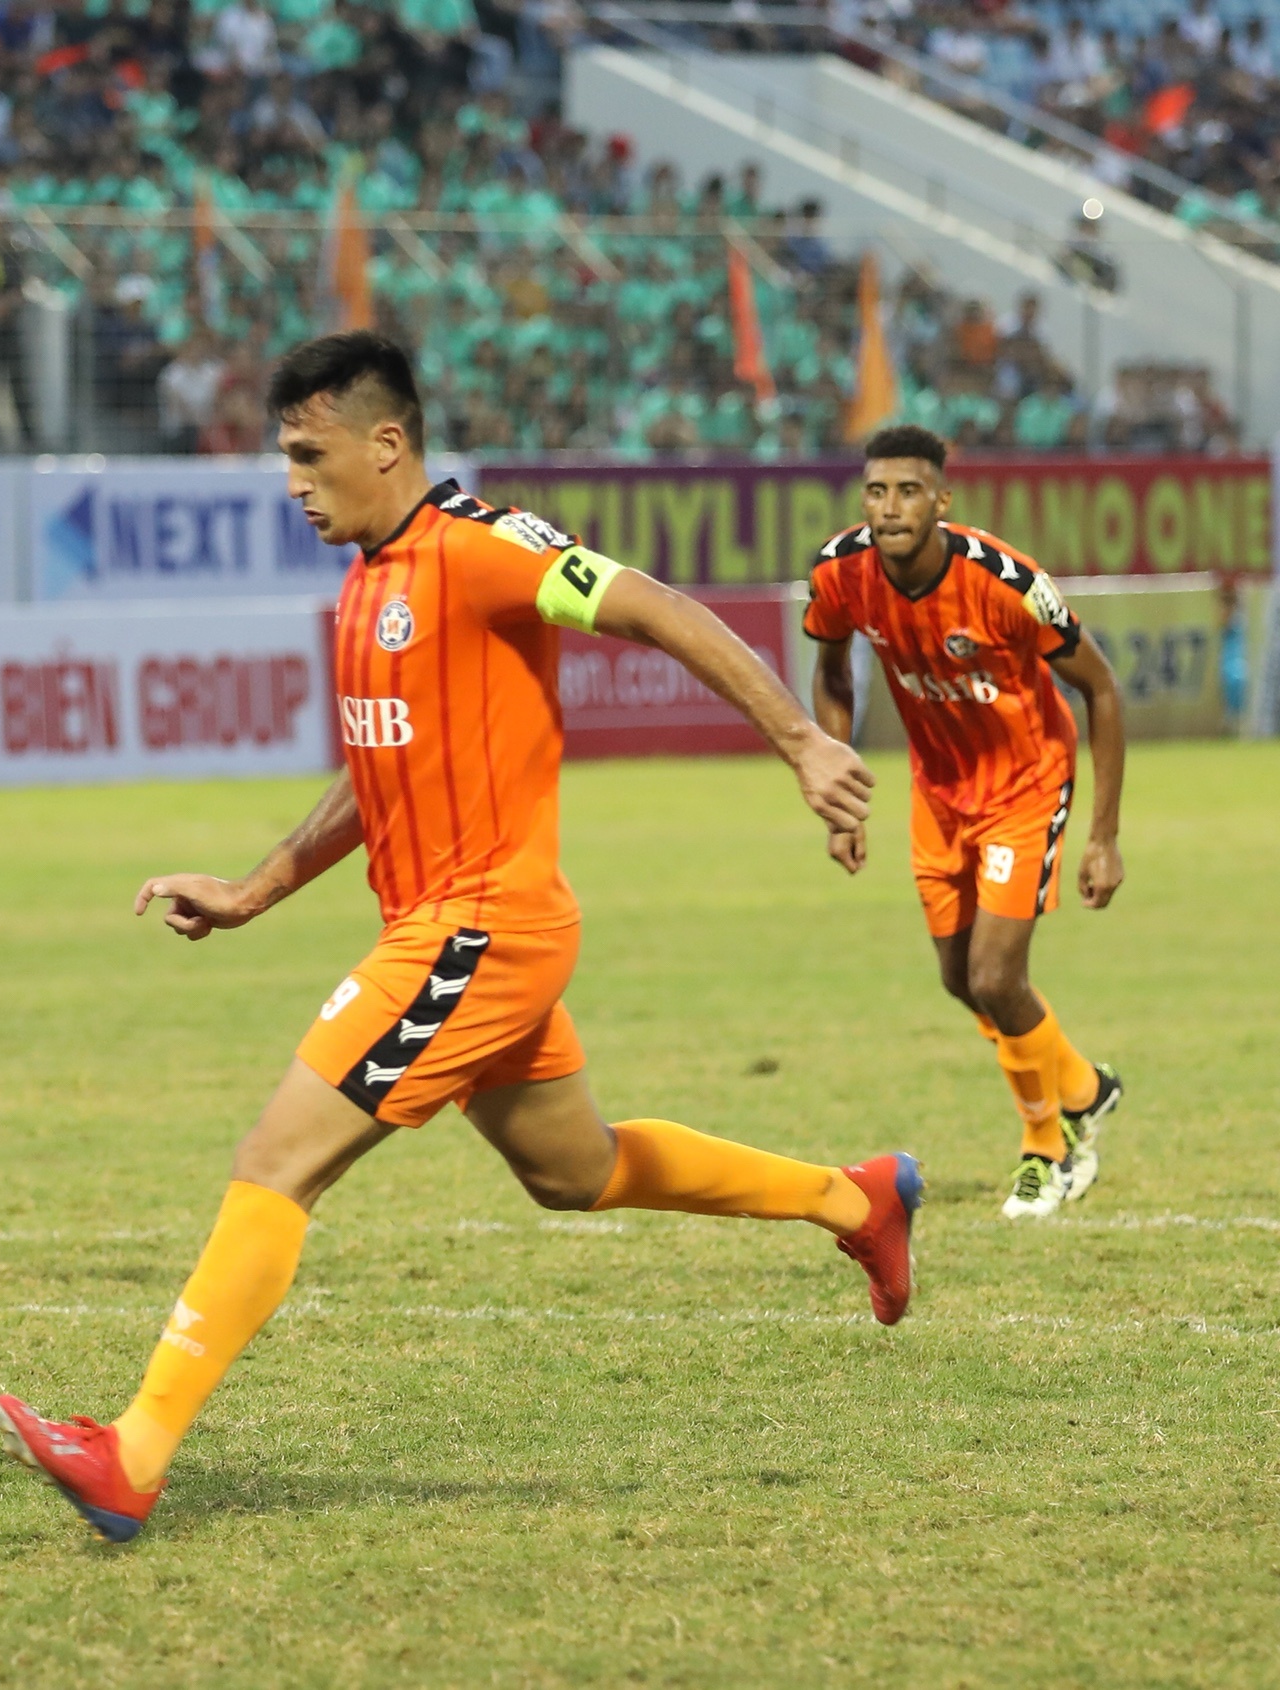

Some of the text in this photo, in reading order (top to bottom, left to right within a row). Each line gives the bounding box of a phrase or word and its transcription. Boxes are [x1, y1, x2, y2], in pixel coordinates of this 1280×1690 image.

[109, 495, 250, 576] NEXT
[561, 554, 598, 598] C
[139, 652, 310, 749] GROUP
[341, 696, 414, 747] SHB
